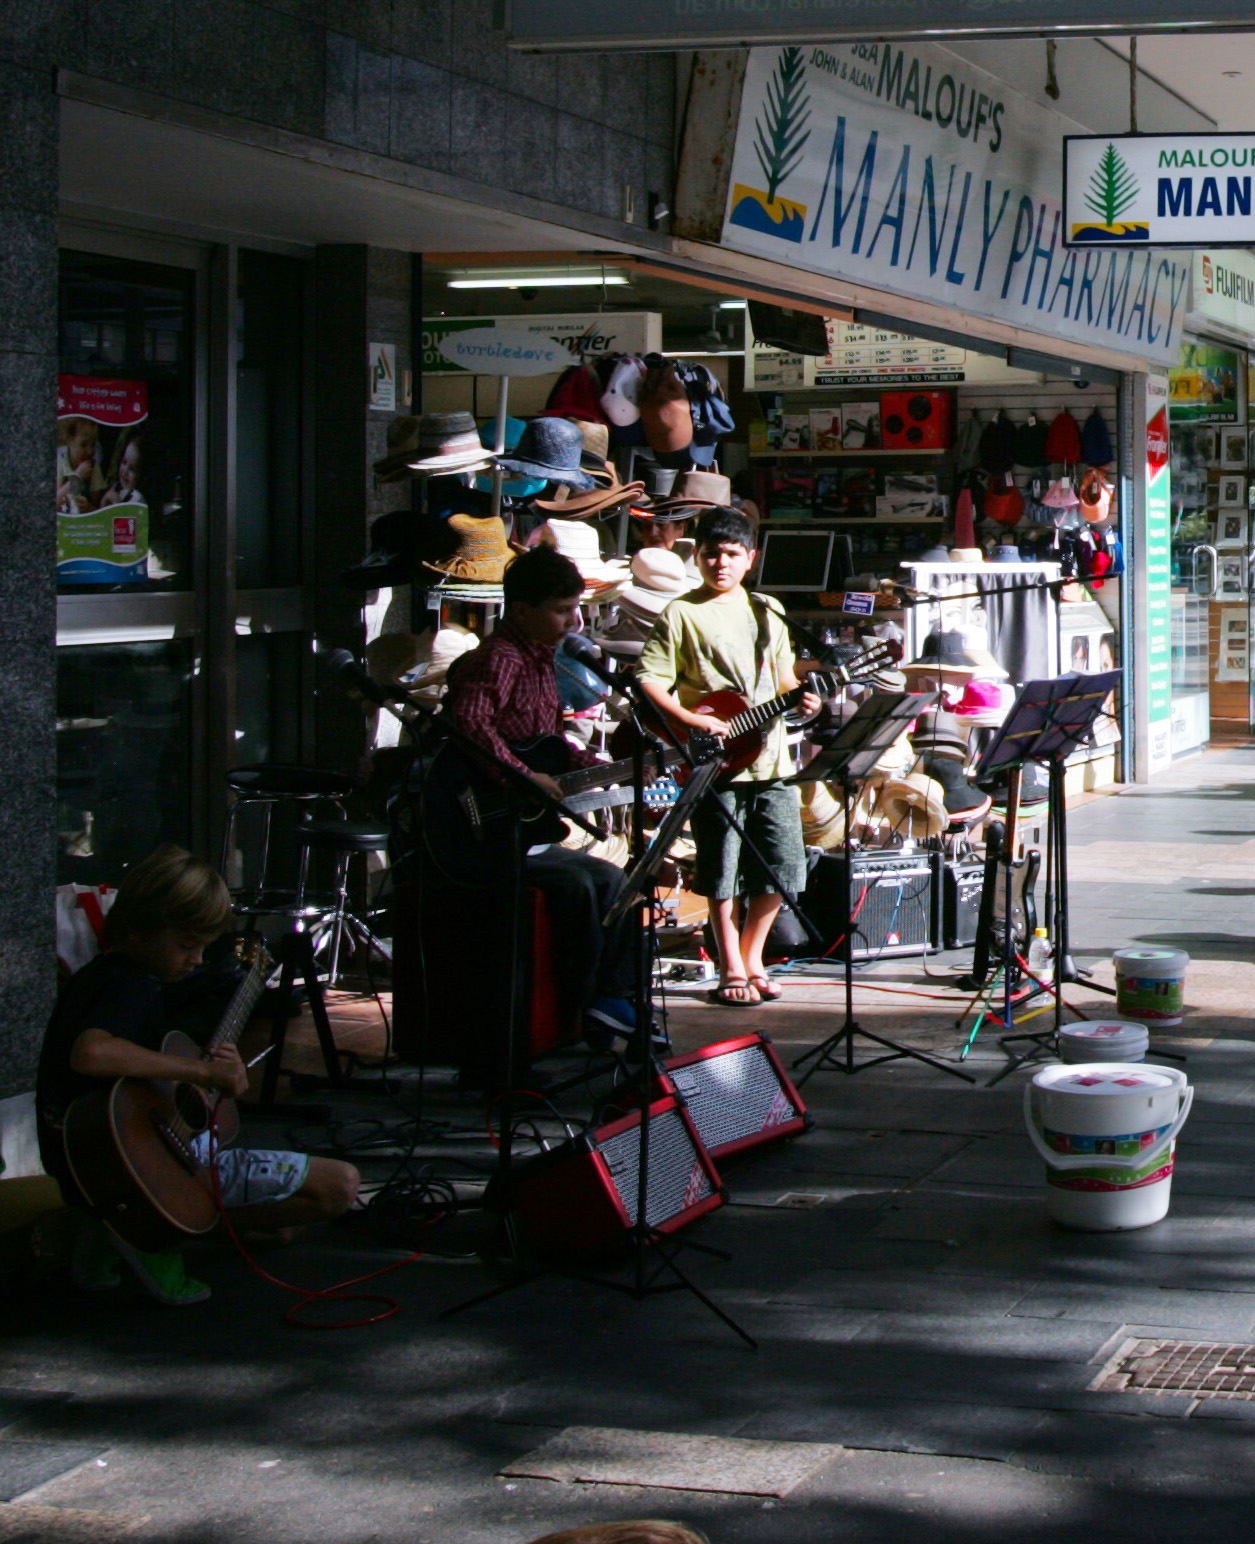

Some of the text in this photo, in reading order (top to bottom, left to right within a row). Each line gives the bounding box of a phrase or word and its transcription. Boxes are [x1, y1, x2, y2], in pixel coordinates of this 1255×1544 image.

[808, 47, 875, 93] JOHN & ALAN
[876, 44, 1005, 153] MALOUF'S
[809, 116, 1187, 349] MANLY PHARMACY
[1215, 264, 1255, 307] FUJIFILM
